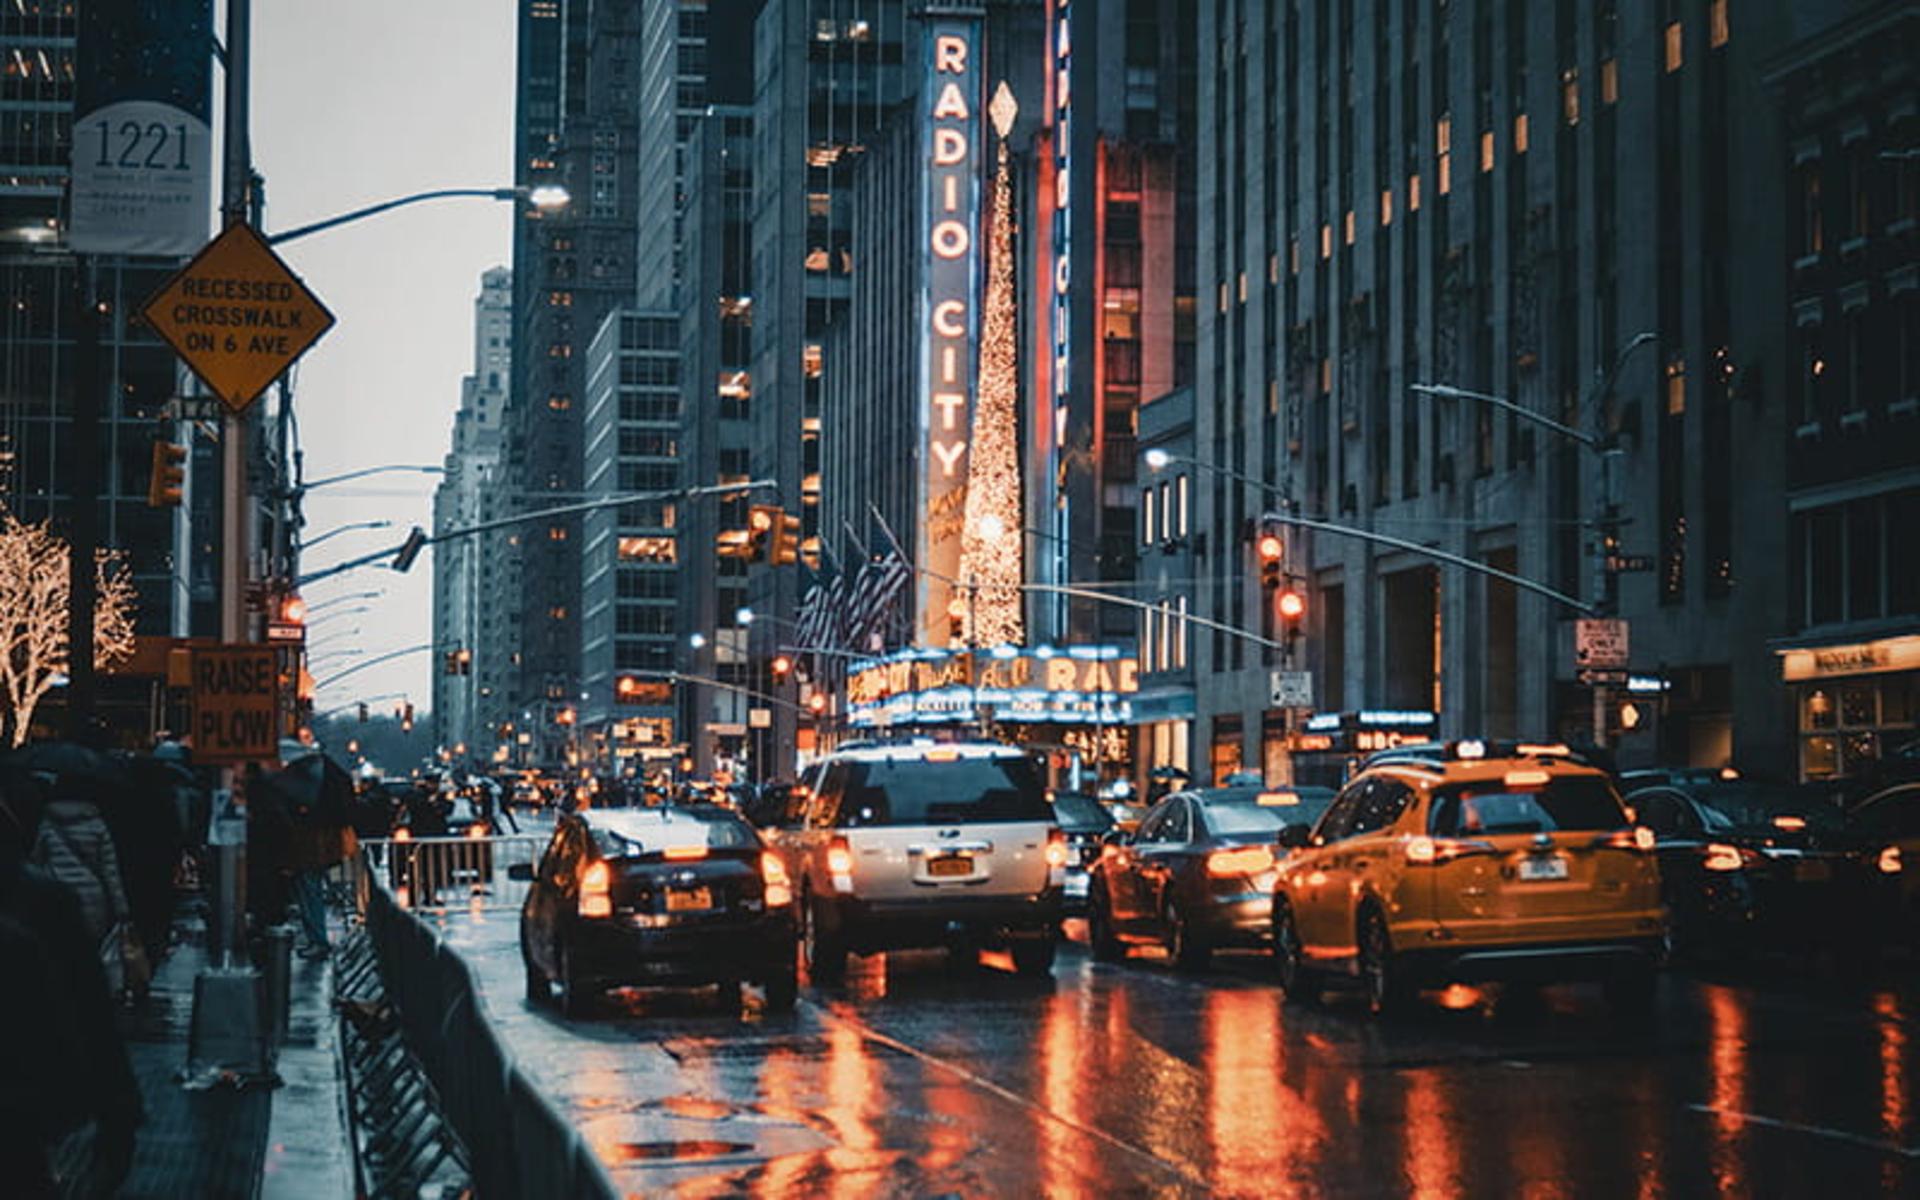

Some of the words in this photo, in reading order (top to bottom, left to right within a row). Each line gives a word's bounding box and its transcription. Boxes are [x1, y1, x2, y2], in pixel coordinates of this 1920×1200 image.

[1057, 0, 1070, 209] ADIO
[95, 120, 191, 171] 1221
[932, 36, 970, 259] RADIO
[182, 277, 293, 302] RECESSED
[173, 303, 304, 328] CROSSWALK
[186, 332, 215, 351] ON
[224, 334, 237, 353] 6
[247, 335, 290, 355] AVE
[932, 300, 966, 477] CITY
[201, 656, 272, 695] RAISE
[201, 709, 271, 748] PLOW
